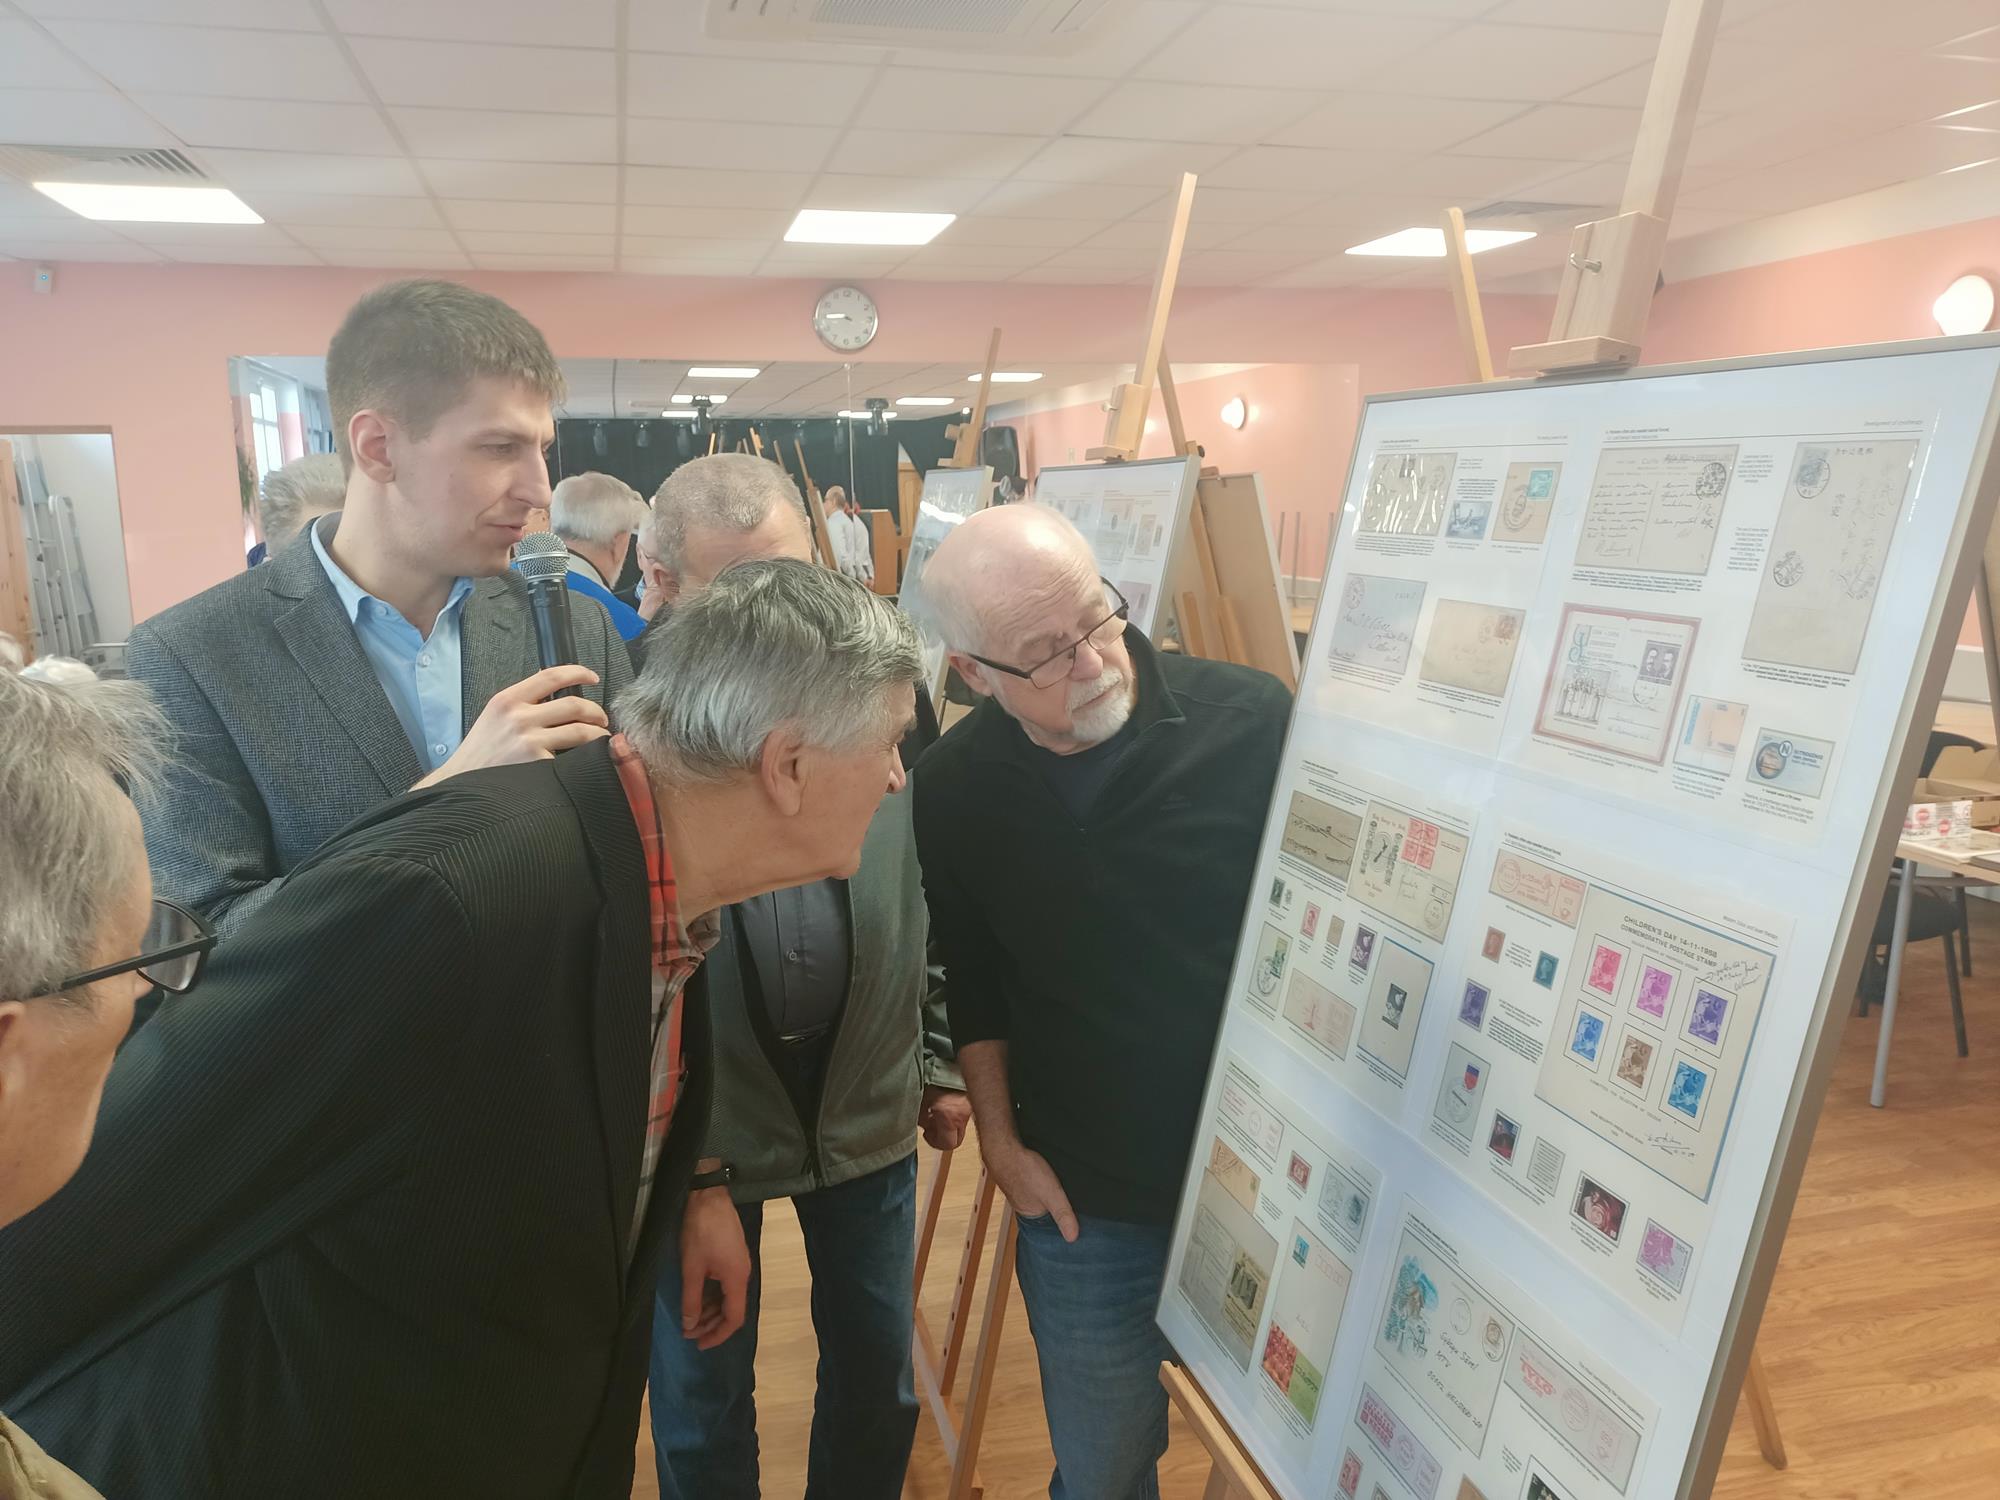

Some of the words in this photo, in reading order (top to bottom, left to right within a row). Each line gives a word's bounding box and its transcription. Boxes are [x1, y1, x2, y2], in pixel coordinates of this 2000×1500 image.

[843, 290, 852, 298] 12
[1781, 743, 1790, 754] N
[1623, 915, 1662, 936] CHILDREN'S
[1664, 931, 1677, 942] DAY
[1620, 924, 1668, 948] COMMEMORATIVE
[1669, 943, 1696, 960] POSTAGE
[1696, 955, 1718, 968] STAMP
